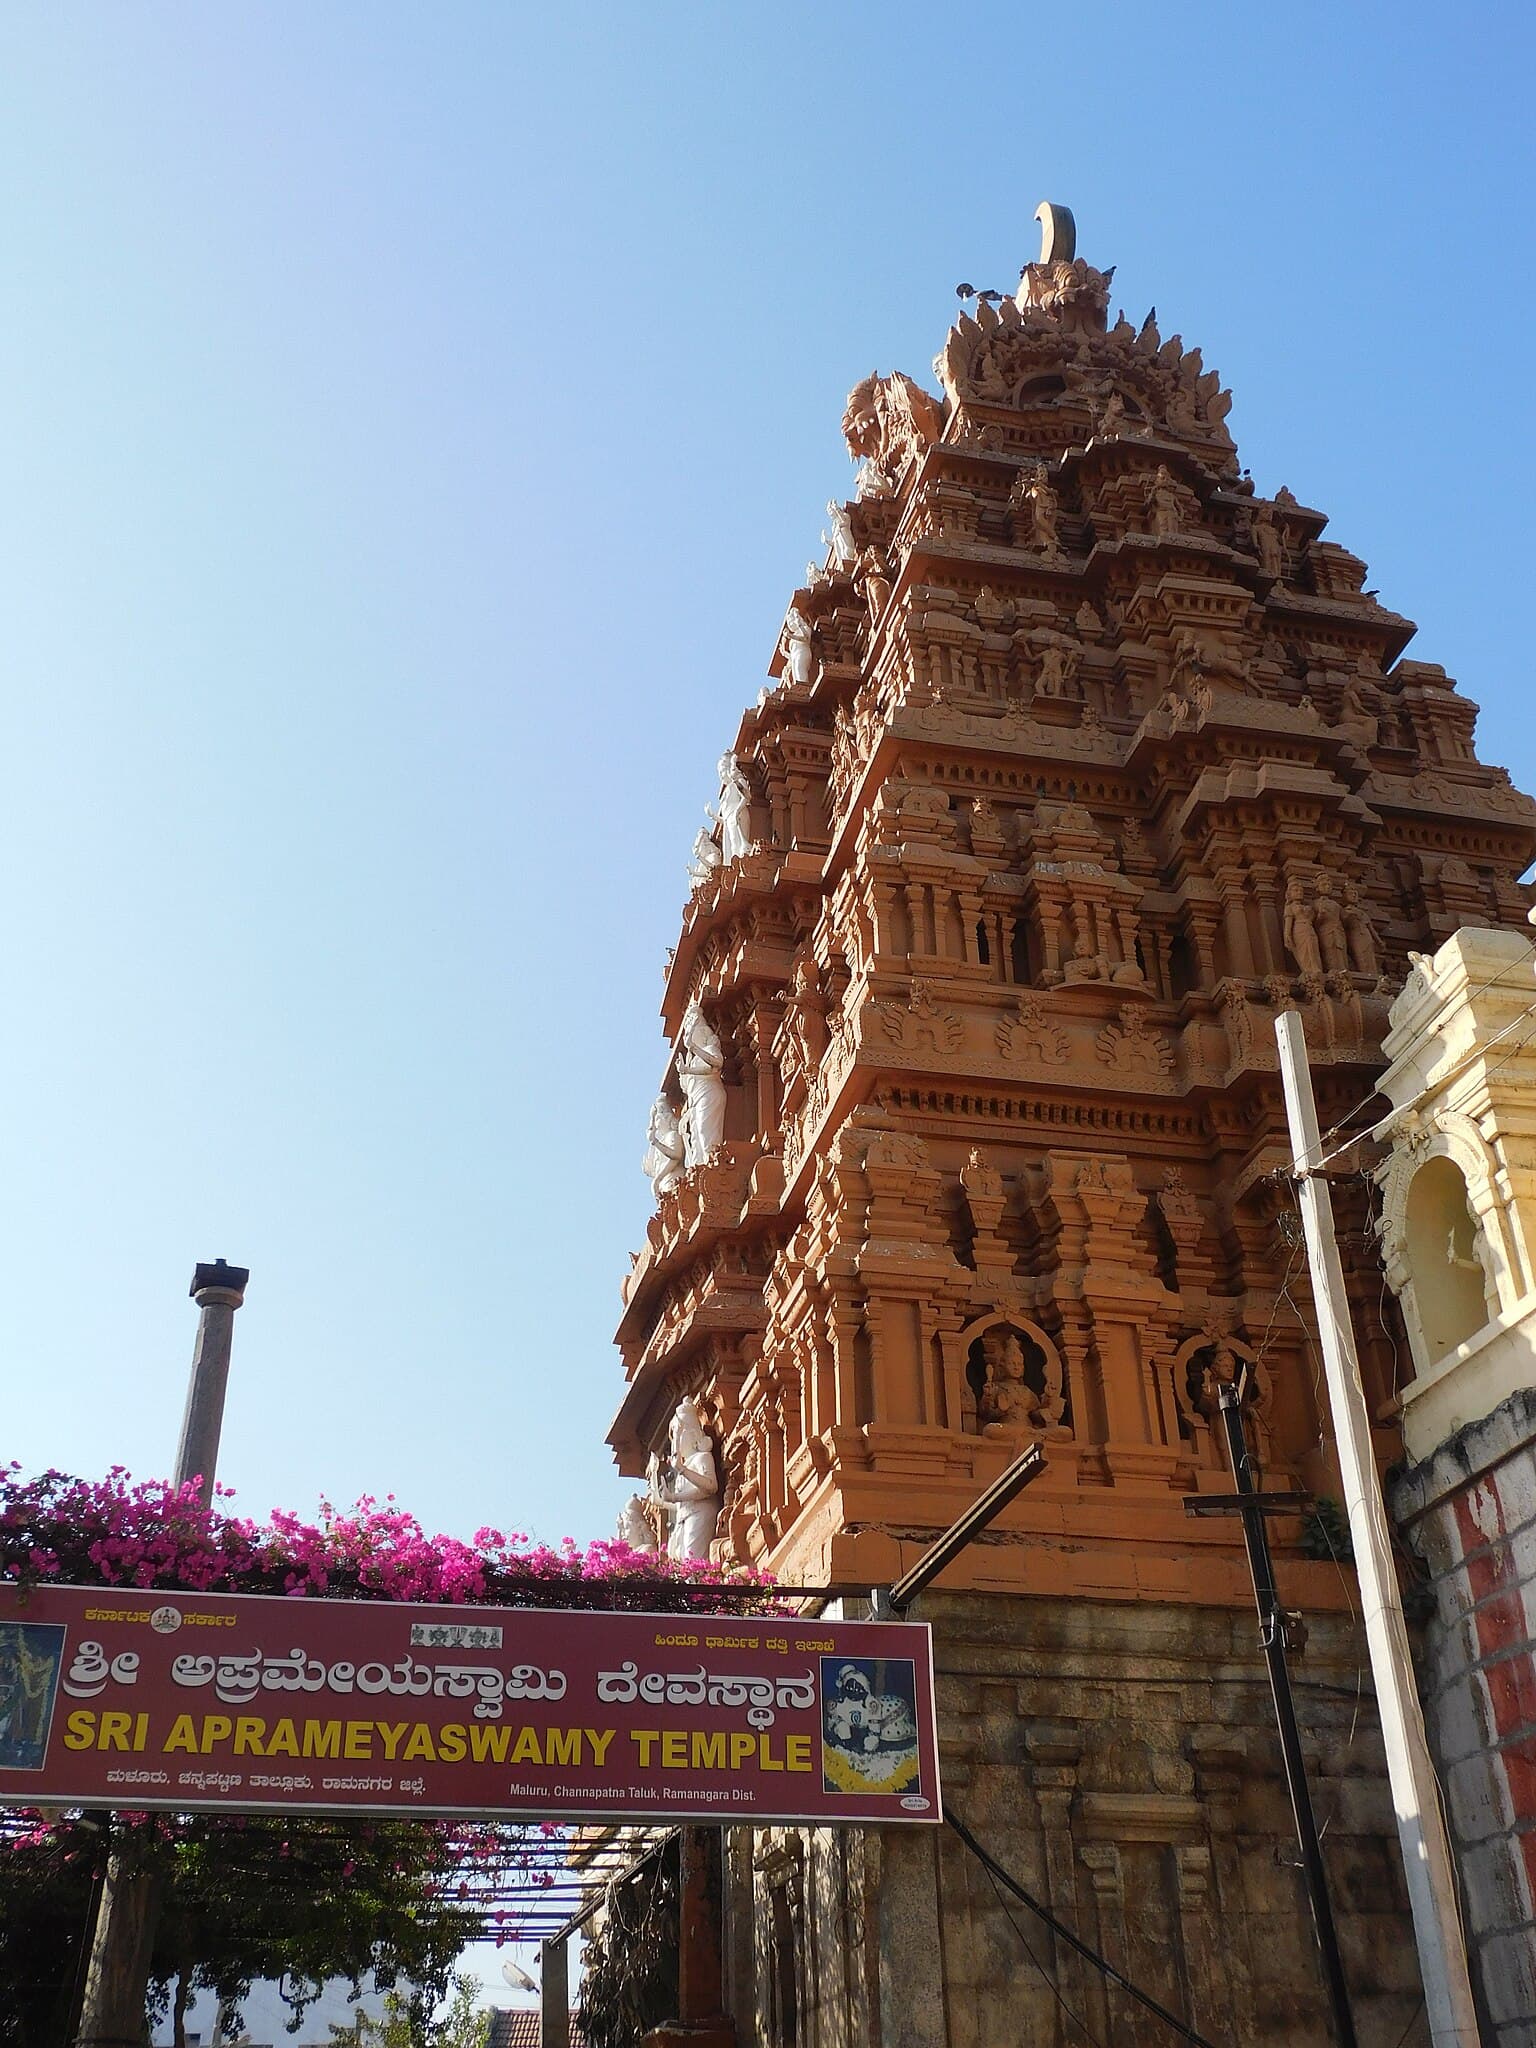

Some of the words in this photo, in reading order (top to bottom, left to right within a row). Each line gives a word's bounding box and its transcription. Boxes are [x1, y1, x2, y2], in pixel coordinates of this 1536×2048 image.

[84, 1608, 151, 1623] ಕರ್ನಾಟಕ
[183, 1612, 238, 1627] ಸರ್ಕಾರ
[655, 1633, 699, 1647] ಹಿಂದೂ
[705, 1636, 760, 1650] ಧಾರ್ಮಿಕ
[766, 1637, 789, 1655] ದತ್ತಿ
[62, 1641, 140, 1698] ಶ್ರೀ
[171, 1646, 567, 1719] ಅಪ್ರಮೇಯಸ್ವಾಮಿ
[597, 1661, 815, 1732] ದೇವಸ್ಥಾನ
[64, 1711, 150, 1752] SRI
[163, 1714, 616, 1766] APRAMEYASWAMY
[630, 1731, 813, 1772] TEMPLE
[178, 1770, 242, 1793] ಚನ್ನಪಟ್ಟಣ
[322, 1775, 393, 1791] ರಾಮನಗರ
[510, 1783, 552, 1799] Maluru,
[553, 1785, 625, 1801] Channapatna
[627, 1787, 661, 1801] Taluk,
[663, 1787, 730, 1803] Ramanagara
[732, 1788, 757, 1801] Dist.
